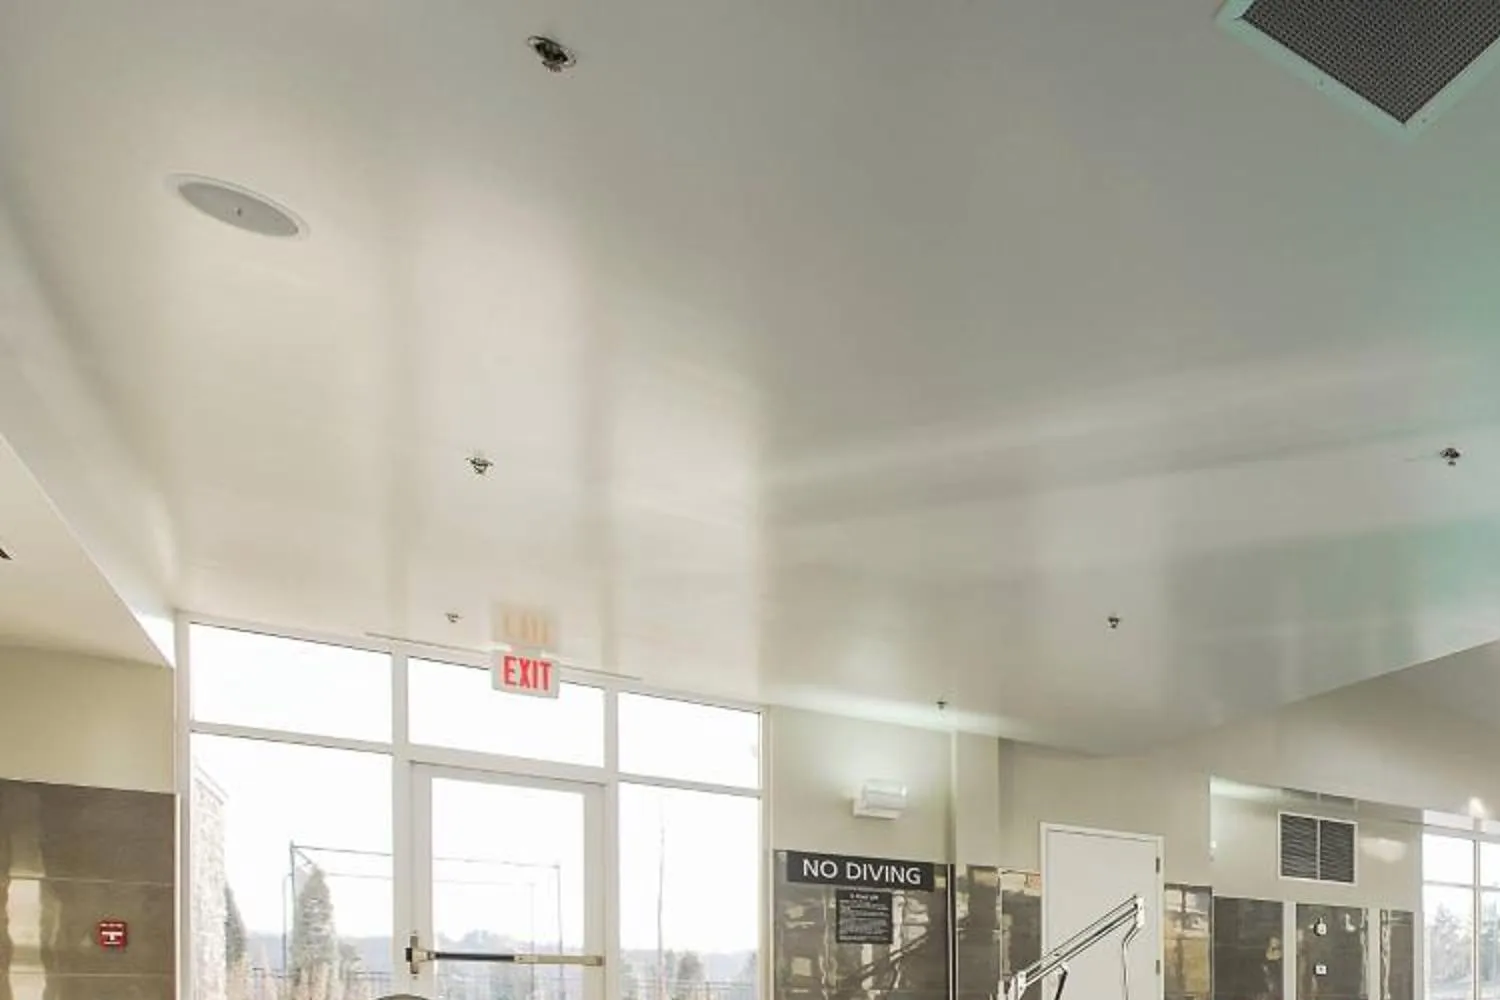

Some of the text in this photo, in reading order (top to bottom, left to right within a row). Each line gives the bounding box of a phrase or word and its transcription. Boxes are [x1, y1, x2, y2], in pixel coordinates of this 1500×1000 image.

[503, 655, 552, 691] EXIT
[802, 859, 921, 885] NO DIVING
